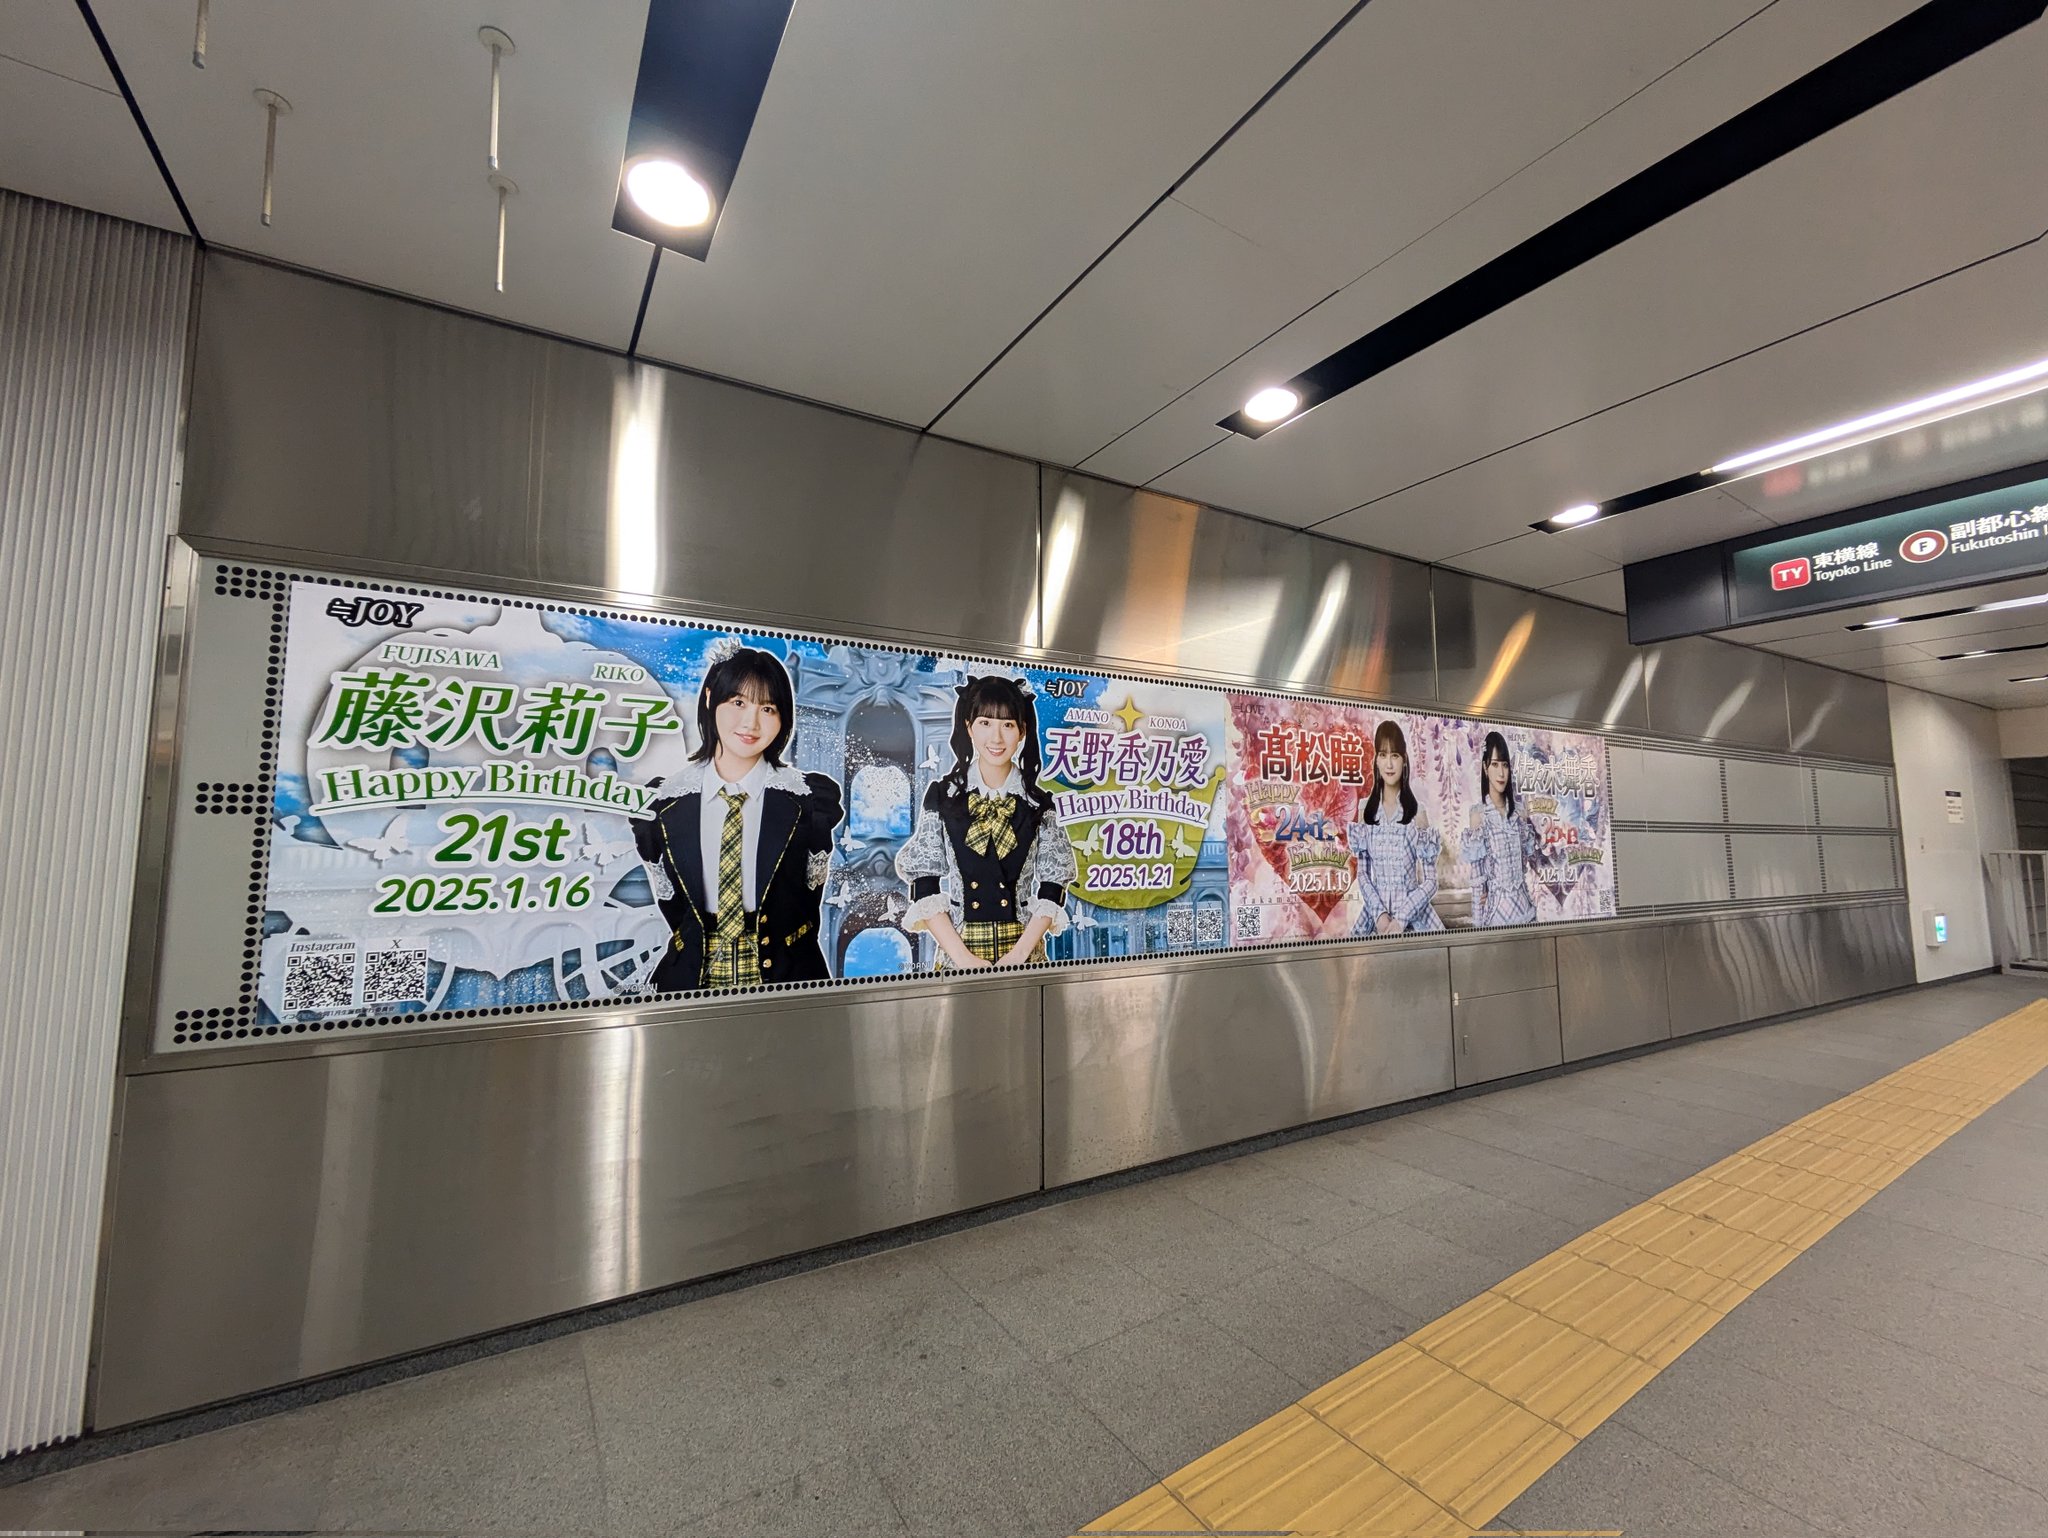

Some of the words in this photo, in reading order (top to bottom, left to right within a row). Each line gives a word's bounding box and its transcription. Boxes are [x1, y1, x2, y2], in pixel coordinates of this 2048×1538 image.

[1919, 541, 1928, 552] F
[1951, 528, 2039, 554] Fukutoshin
[1812, 542, 1880, 569] 東横線
[1778, 567, 1803, 582] TY
[1814, 563, 1860, 582] Toyoko
[1864, 558, 1893, 572] Line
[381, 643, 500, 670] FUJISAWA
[596, 664, 645, 683] RIKO
[318, 671, 681, 759] 藤沢莉子
[1066, 709, 1109, 724] AMANO
[1149, 717, 1187, 730] KONOA
[1044, 728, 1208, 786] 天野香乃愛
[322, 766, 477, 805] Happy
[487, 763, 657, 814] Birthday
[1058, 791, 1127, 818] Happy
[1128, 789, 1207, 822] Birthday
[434, 812, 572, 863] 21st
[1101, 822, 1162, 856] 18th
[1086, 864, 1174, 889] 2025.1.21
[1288, 871, 1351, 893] 2025.1.19
[373, 874, 591, 913] 2025.1.16
[290, 942, 356, 954] Instagram
[391, 939, 403, 949] X
